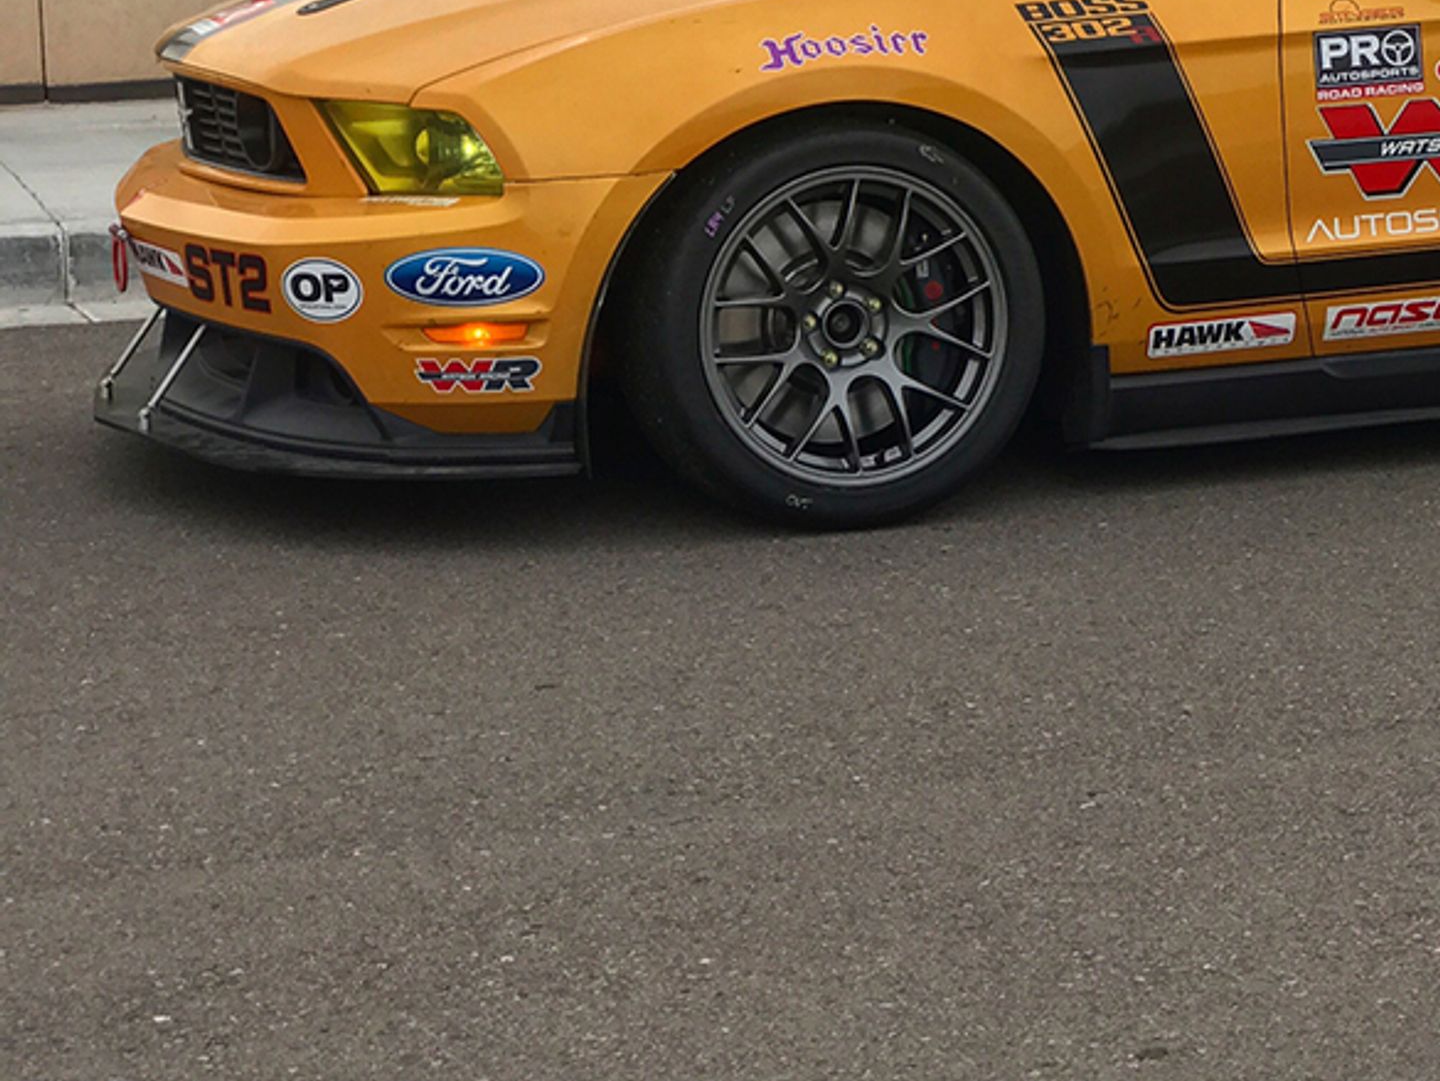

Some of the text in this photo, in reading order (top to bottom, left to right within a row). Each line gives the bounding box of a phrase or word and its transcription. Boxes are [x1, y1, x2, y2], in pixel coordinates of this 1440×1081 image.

[760, 24, 928, 70] Hoosier
[1320, 66, 1419, 83] AUTOSPORTS
[1317, 82, 1424, 100] ROAD RACING
[185, 243, 272, 314] ST2
[291, 273, 350, 303] OP
[415, 256, 514, 296] Ford
[1152, 321, 1246, 350] HAWK
